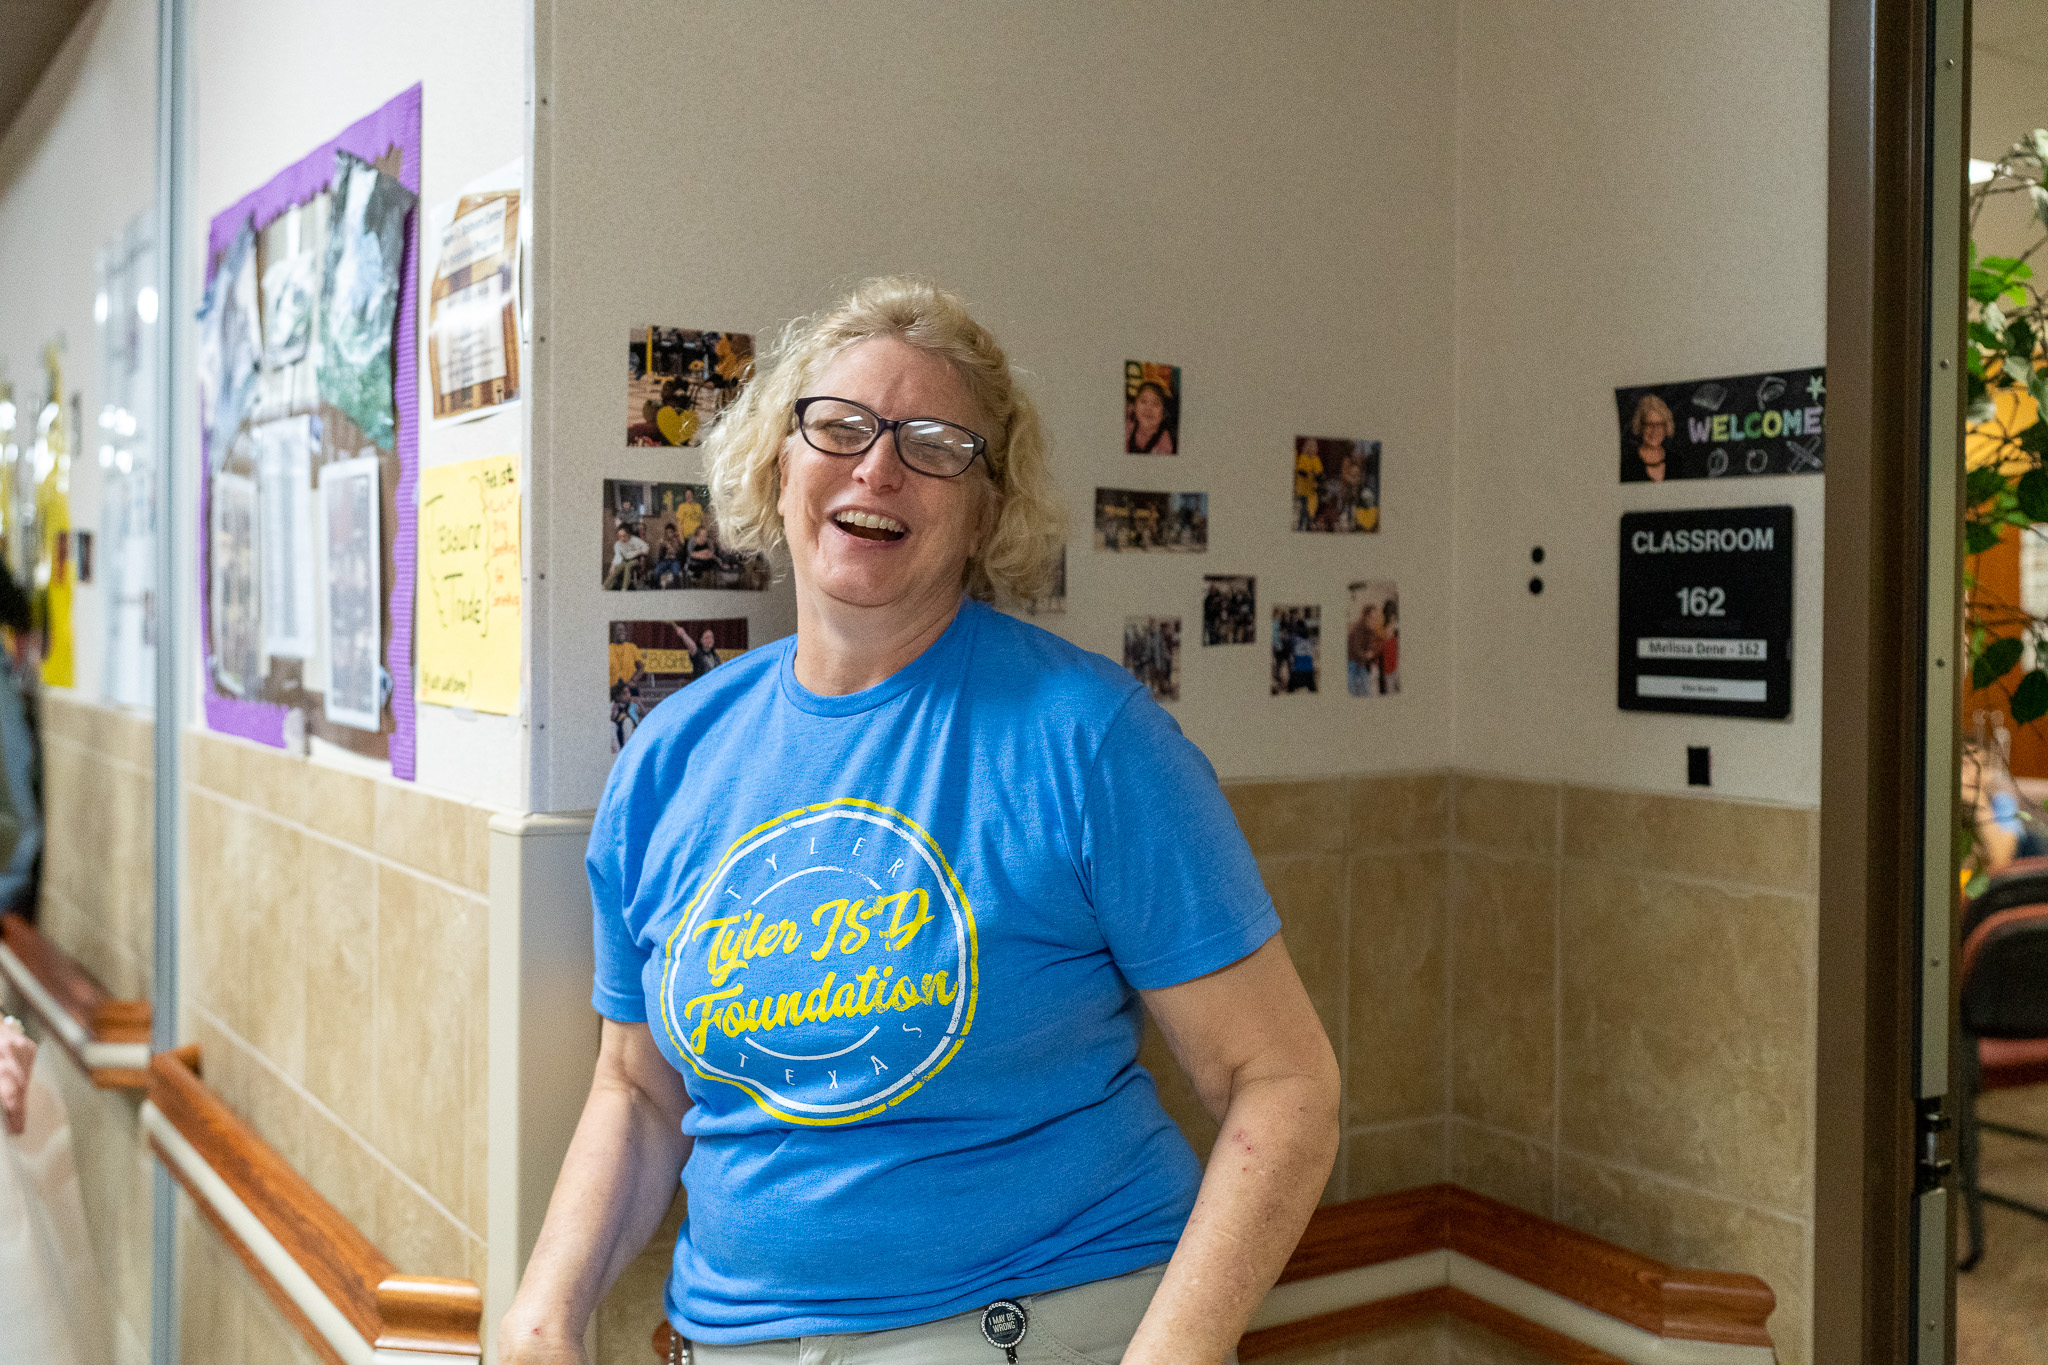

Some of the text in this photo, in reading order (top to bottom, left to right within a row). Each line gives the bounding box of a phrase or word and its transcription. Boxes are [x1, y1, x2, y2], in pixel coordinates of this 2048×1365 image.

[1688, 406, 1823, 443] WELCOME
[1631, 527, 1775, 554] CLASSROOM
[1675, 586, 1726, 617] 162
[1649, 641, 1693, 655] Melissa
[1738, 642, 1760, 657] 162
[725, 837, 906, 901] TYLER
[692, 887, 935, 987] Tyler ISD
[685, 965, 958, 1055] Foundation
[738, 1023, 922, 1090] TEXAS
[992, 1314, 1005, 1324] MAY
[1006, 1313, 1015, 1321] BE
[993, 1321, 1016, 1333] WRONG
